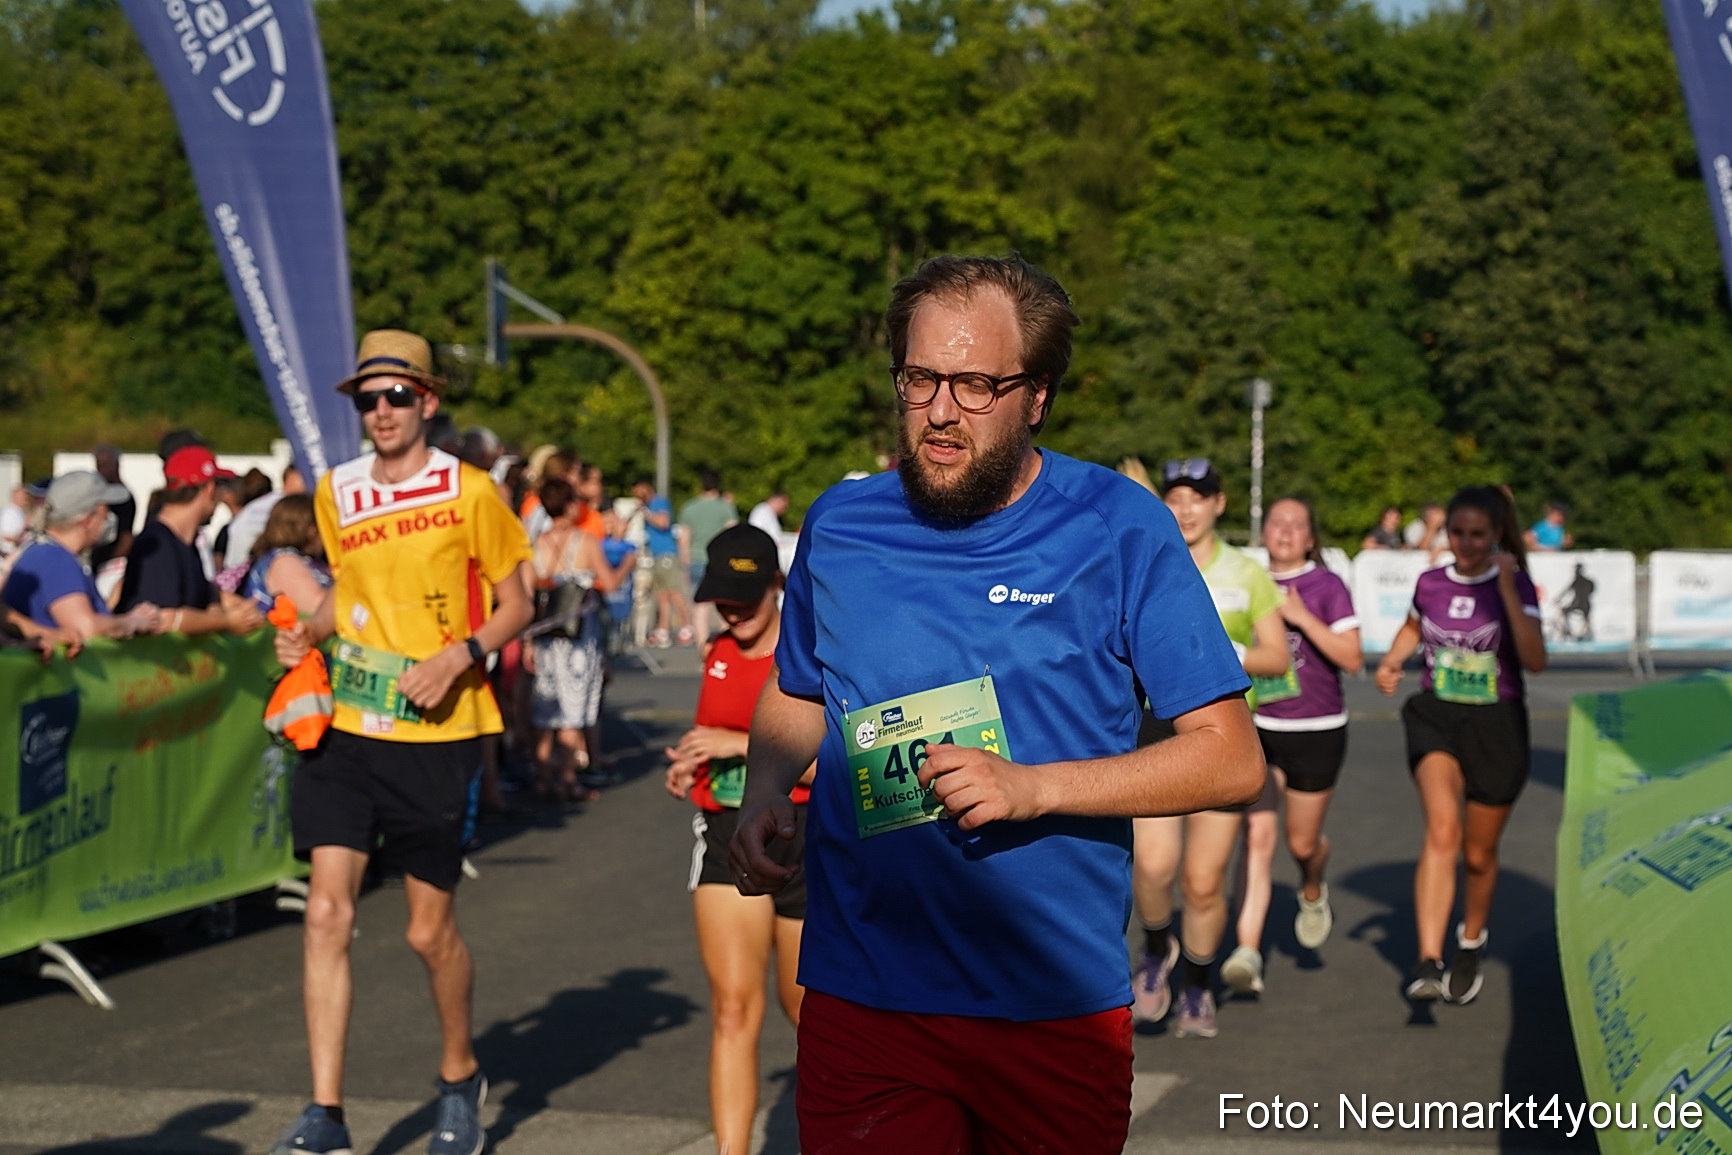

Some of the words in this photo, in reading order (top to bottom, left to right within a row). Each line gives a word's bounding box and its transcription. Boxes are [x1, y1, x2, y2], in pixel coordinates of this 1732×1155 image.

[340, 524, 387, 553] MAX
[396, 508, 465, 536] BÖGL
[1010, 588, 1055, 606] Berger
[878, 715, 923, 738] Firmenlauf
[896, 724, 924, 738] neumarkt
[883, 731, 955, 784] 46
[857, 767, 874, 811] RUN
[875, 786, 934, 809] Kutsche
